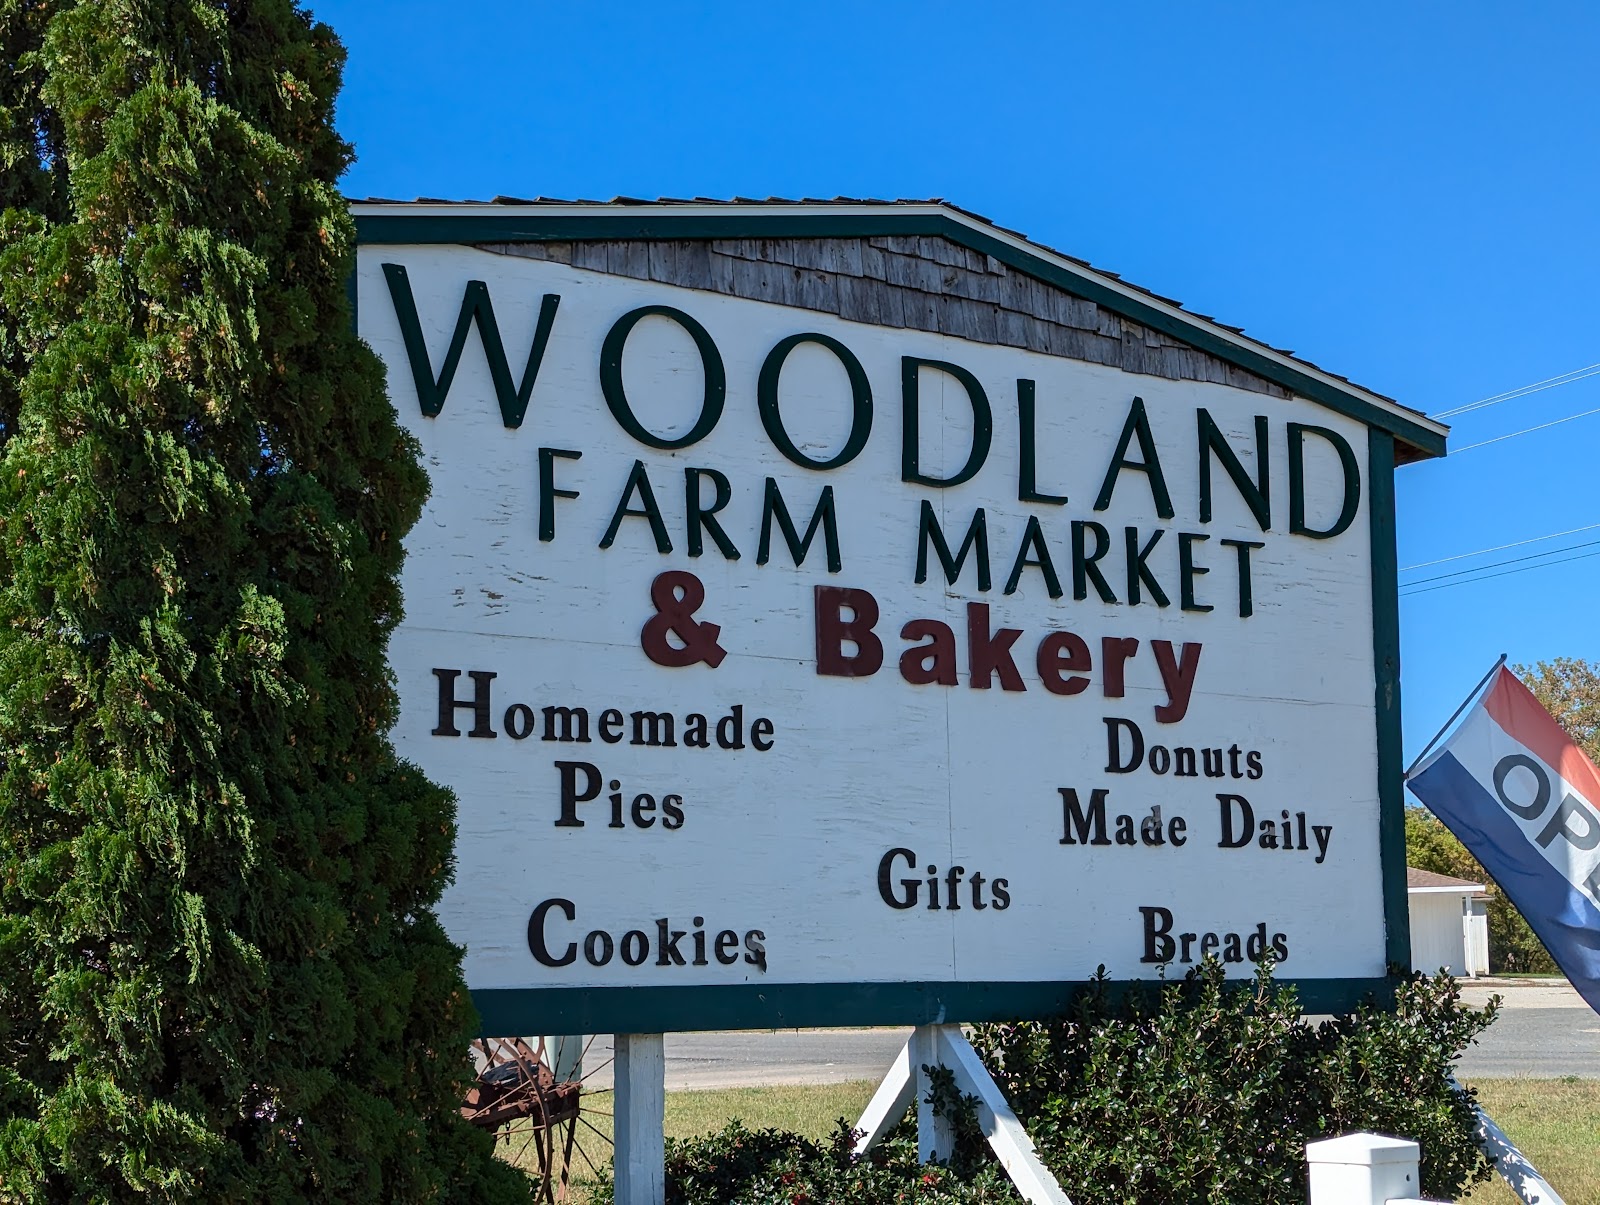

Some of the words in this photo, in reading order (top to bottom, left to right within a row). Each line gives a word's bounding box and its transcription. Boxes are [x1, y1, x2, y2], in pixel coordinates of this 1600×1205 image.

[381, 262, 1361, 540] WOODLAND
[538, 447, 842, 573] FARM
[914, 499, 1266, 618] MARKET
[641, 570, 728, 669] &
[815, 584, 1202, 724] Bakery
[431, 668, 775, 752] Homemade
[1102, 716, 1264, 780] Donuts
[553, 760, 685, 830] Pies
[1058, 787, 1188, 847] Made
[1215, 792, 1333, 864] Daily
[1493, 753, 1600, 904] OP
[877, 847, 1011, 911] Gifts
[527, 897, 767, 972] Cookies
[1138, 906, 1289, 964] Breads
